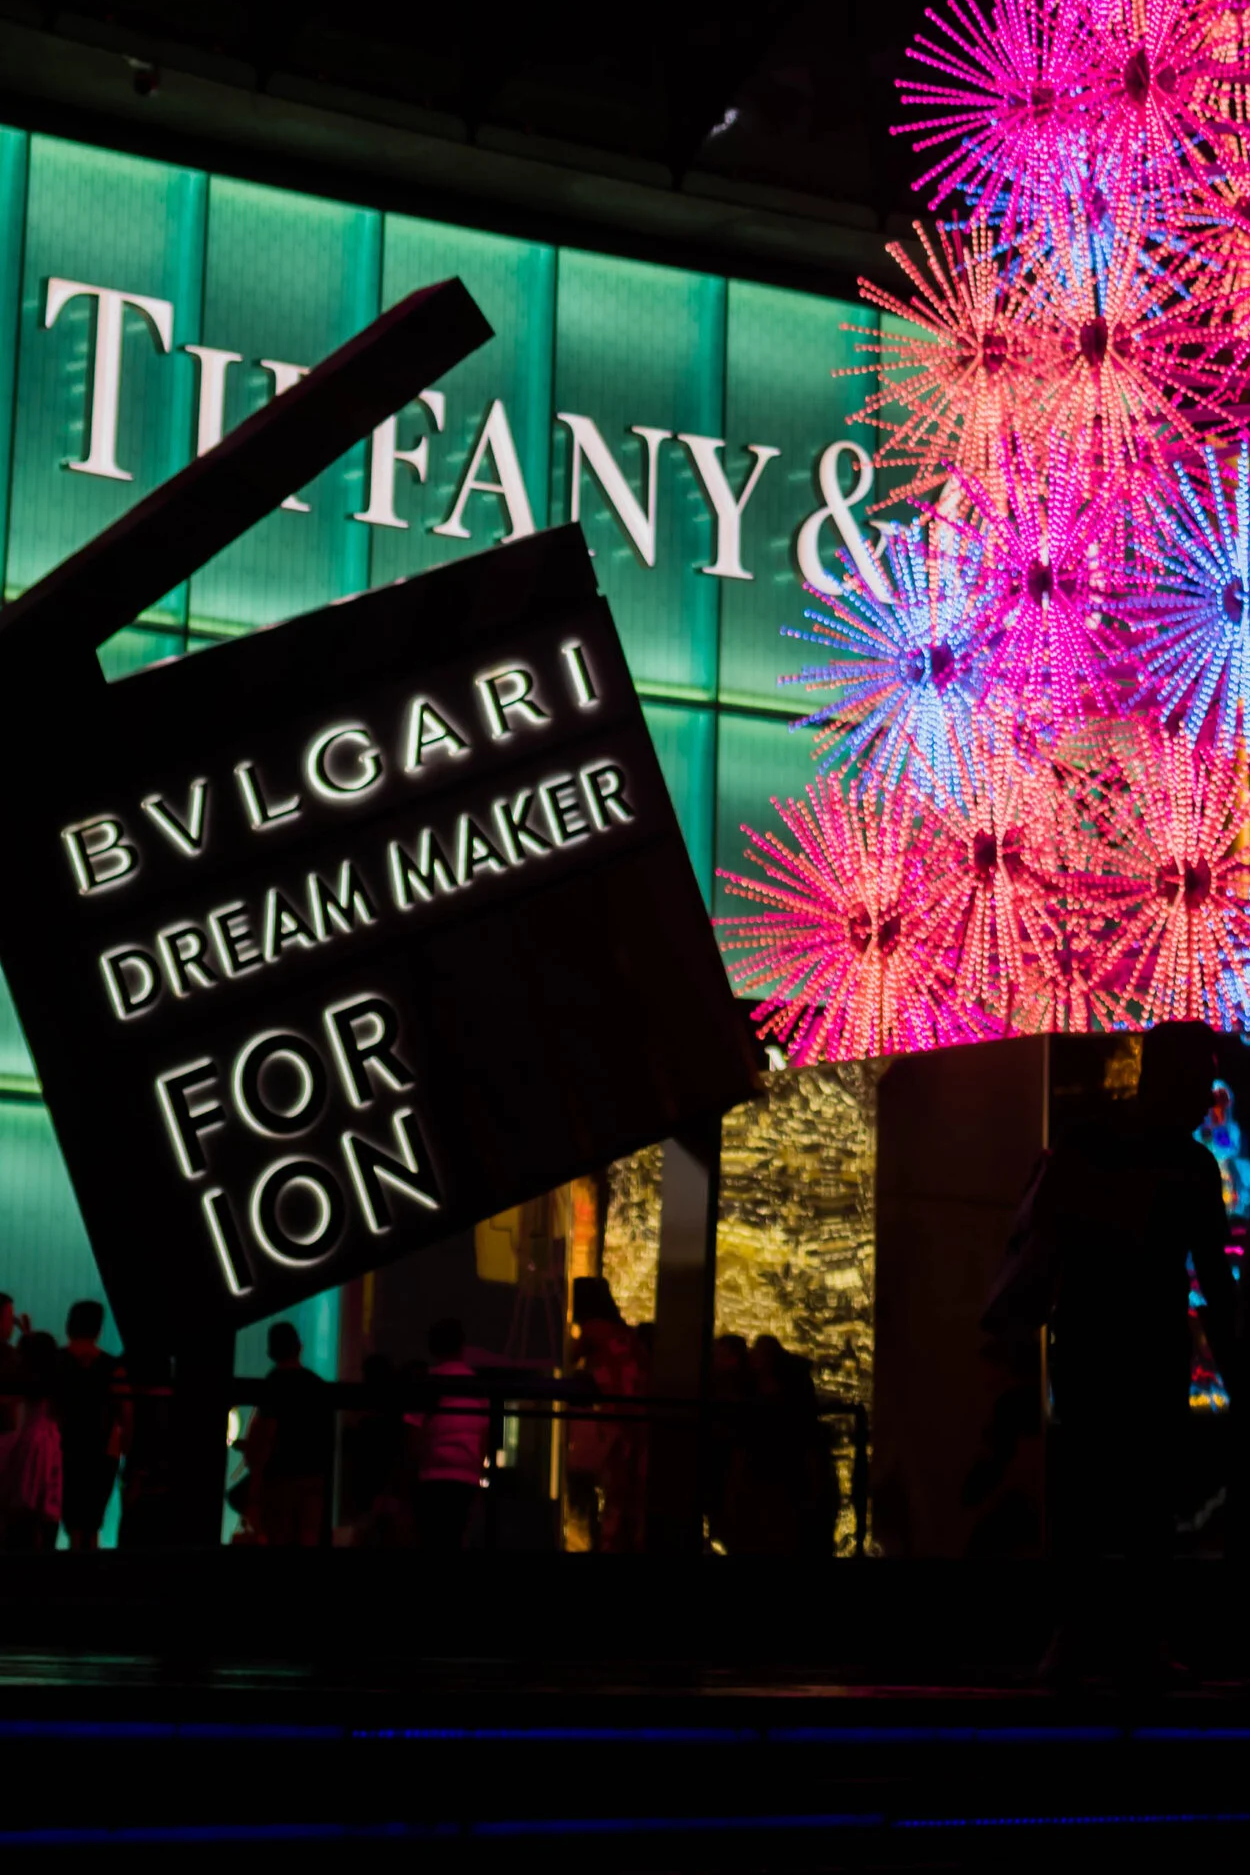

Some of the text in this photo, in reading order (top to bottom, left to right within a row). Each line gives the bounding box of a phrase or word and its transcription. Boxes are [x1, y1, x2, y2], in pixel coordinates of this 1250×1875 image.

[60, 621, 602, 895] BVLGARI
[99, 760, 634, 1021] DREAM MAKER
[154, 992, 414, 1180] FOR
[201, 1107, 443, 1296] ION
